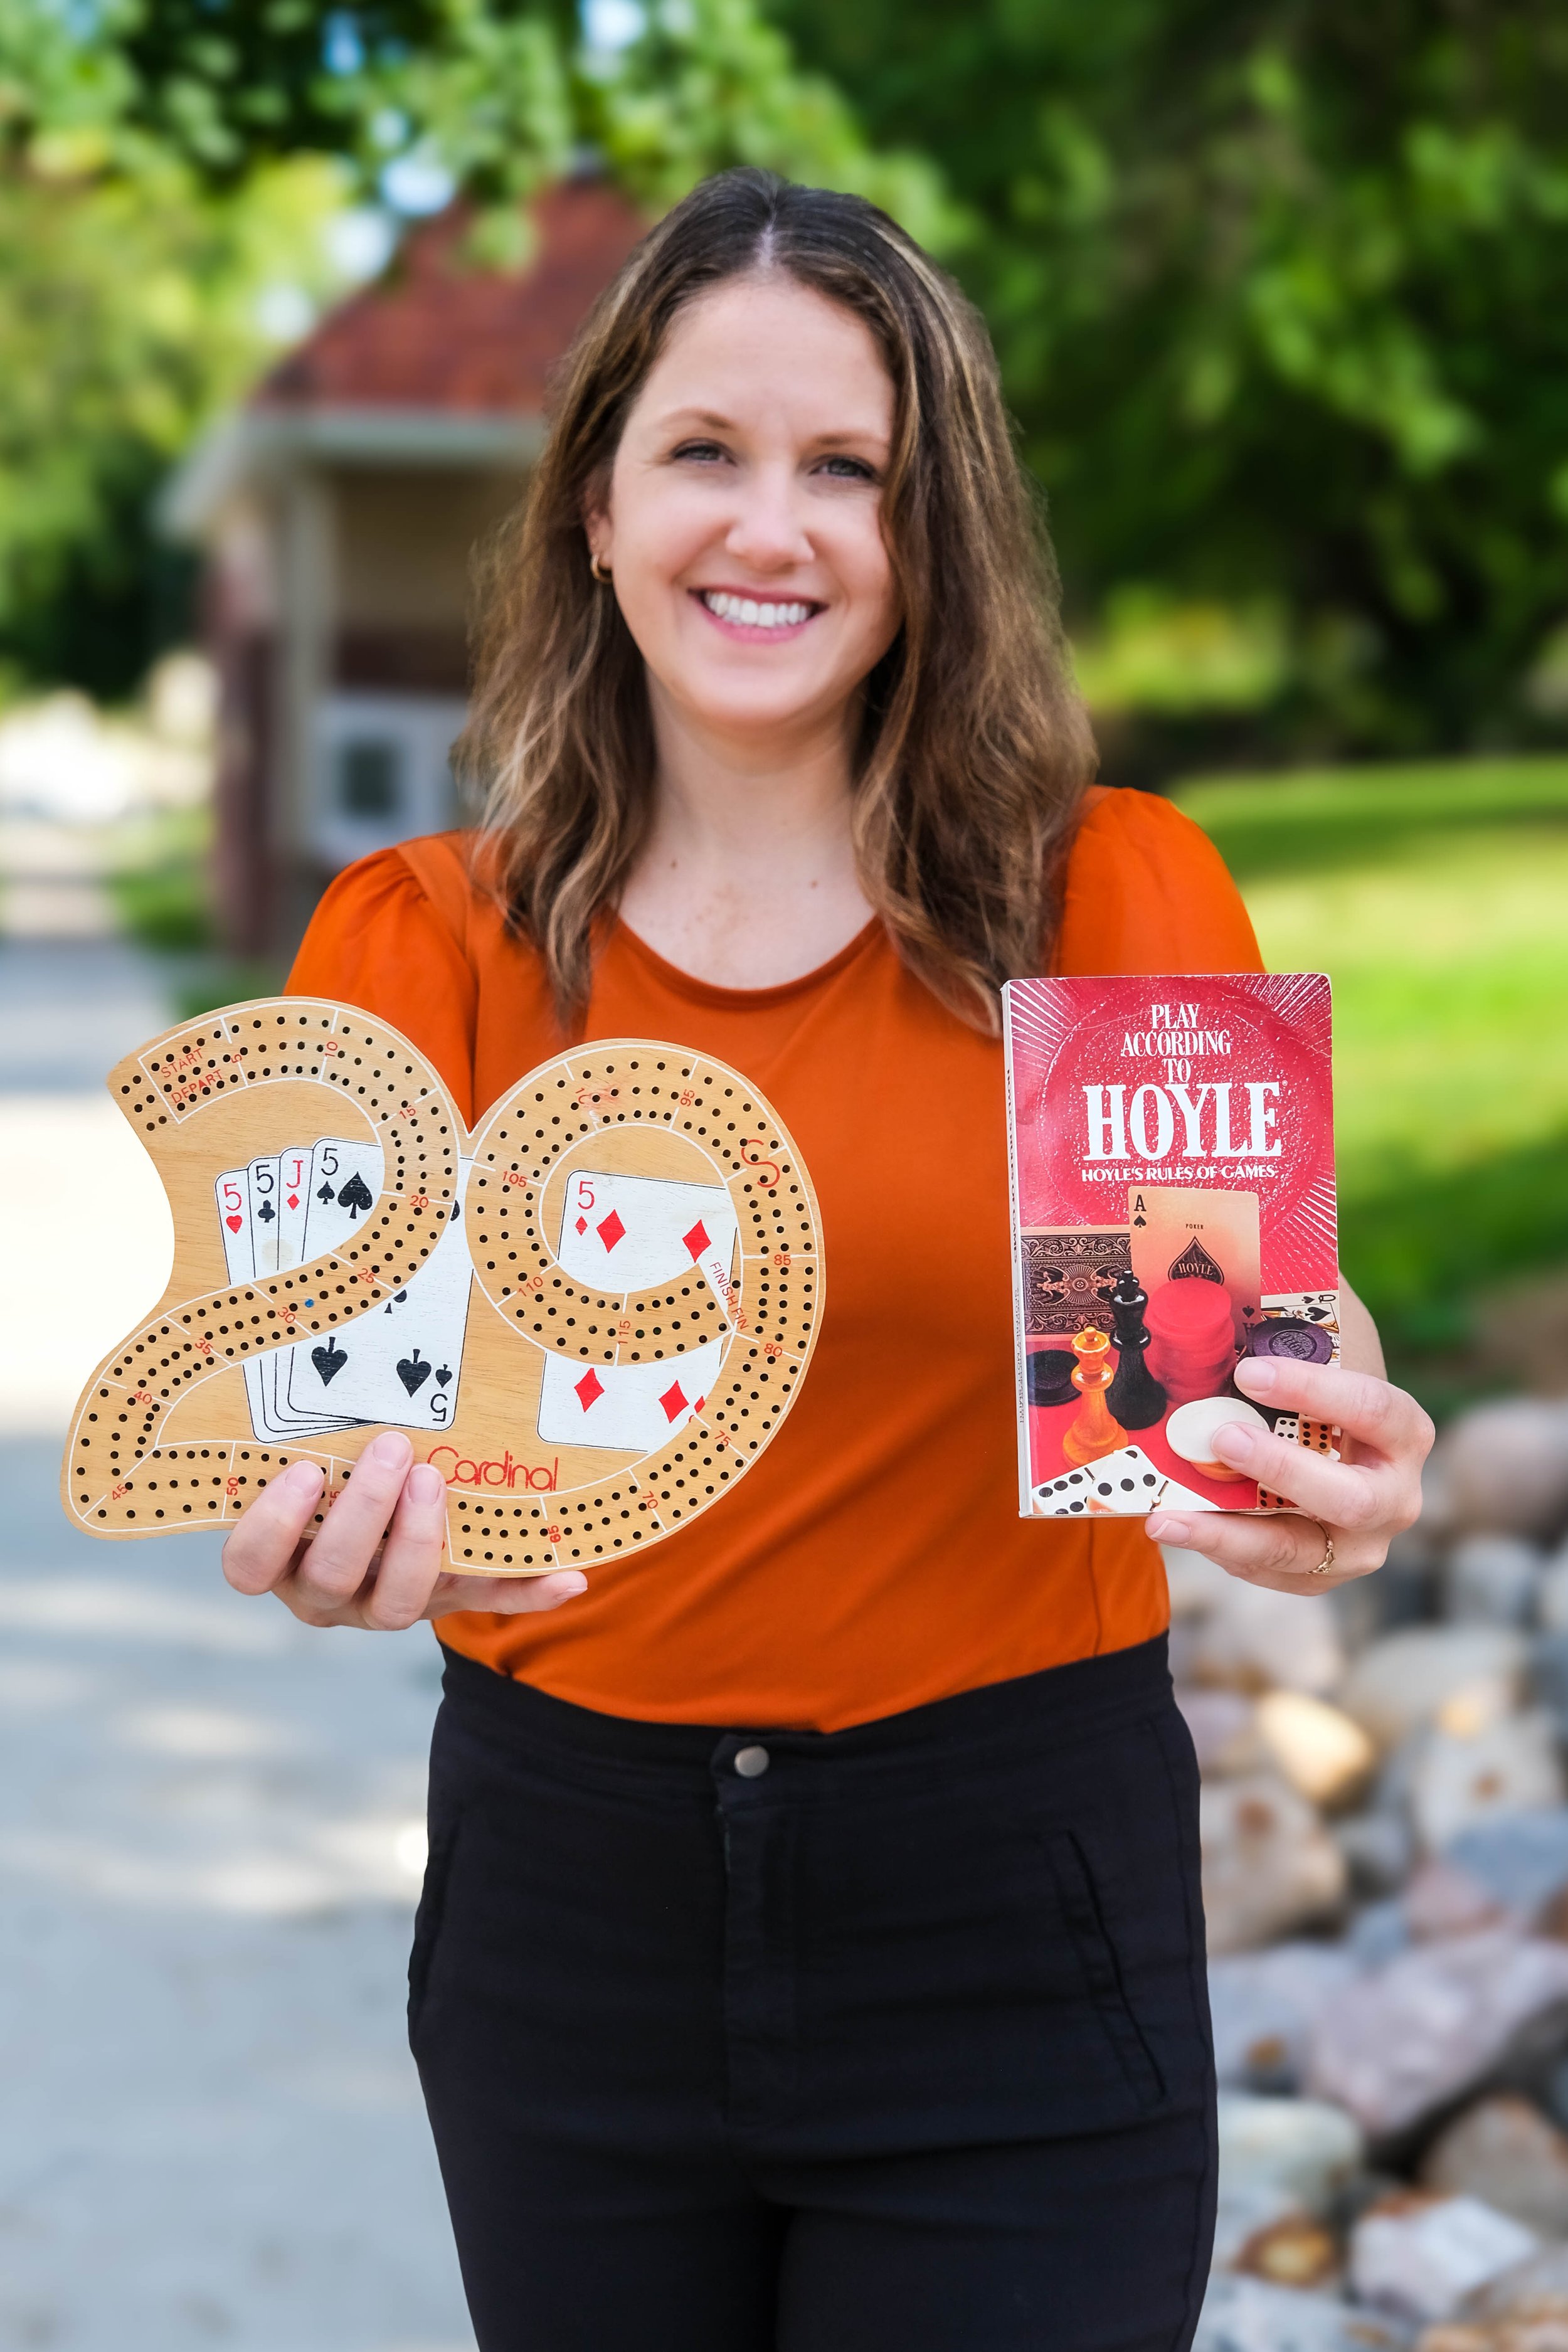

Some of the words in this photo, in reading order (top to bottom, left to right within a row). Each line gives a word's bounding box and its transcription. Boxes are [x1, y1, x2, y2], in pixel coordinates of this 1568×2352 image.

[1150, 1004, 1200, 1029] PLAY
[324, 1041, 339, 1058] 10
[1120, 1030, 1231, 1057] ACCORDING
[161, 1048, 204, 1078] START
[231, 1053, 243, 1064] 5
[1163, 1058, 1192, 1083] TO
[170, 1069, 223, 1104] DEPART
[680, 1088, 695, 1106] 95
[399, 1105, 416, 1120] 15
[1082, 1081, 1282, 1161] HOYLE
[321, 1147, 339, 1176] 5
[741, 1139, 780, 1188] S
[255, 1164, 275, 1194] 5
[286, 1160, 304, 1189] J
[502, 1170, 527, 1188] 105
[1081, 1166, 1144, 1182] HOYLE'S
[1146, 1165, 1194, 1181] RULES
[1196, 1165, 1218, 1180] OF
[1221, 1164, 1276, 1180] GAMES
[223, 1182, 243, 1211] 5
[410, 1194, 429, 1208] 20
[578, 1180, 595, 1210] 5
[1133, 1194, 1147, 1212] A
[774, 1254, 792, 1266] 85
[1178, 1262, 1214, 1276] HOYLE
[358, 1268, 376, 1283] 25
[518, 1276, 544, 1296] 110
[709, 1261, 738, 1309] FINISH
[731, 1306, 749, 1330] FIN
[1318, 1295, 1336, 1303] Q
[278, 1306, 296, 1323] 30
[618, 1320, 631, 1345] 115
[195, 1338, 213, 1355] 35
[764, 1343, 783, 1357] 80
[133, 1390, 153, 1405] 40
[430, 1393, 448, 1422] 5
[714, 1430, 731, 1447] 75
[428, 1446, 559, 1491] Cardinal
[112, 1483, 129, 1501] 45
[226, 1476, 240, 1496] 50
[642, 1491, 659, 1510] 70
[548, 1525, 561, 1544] 65
